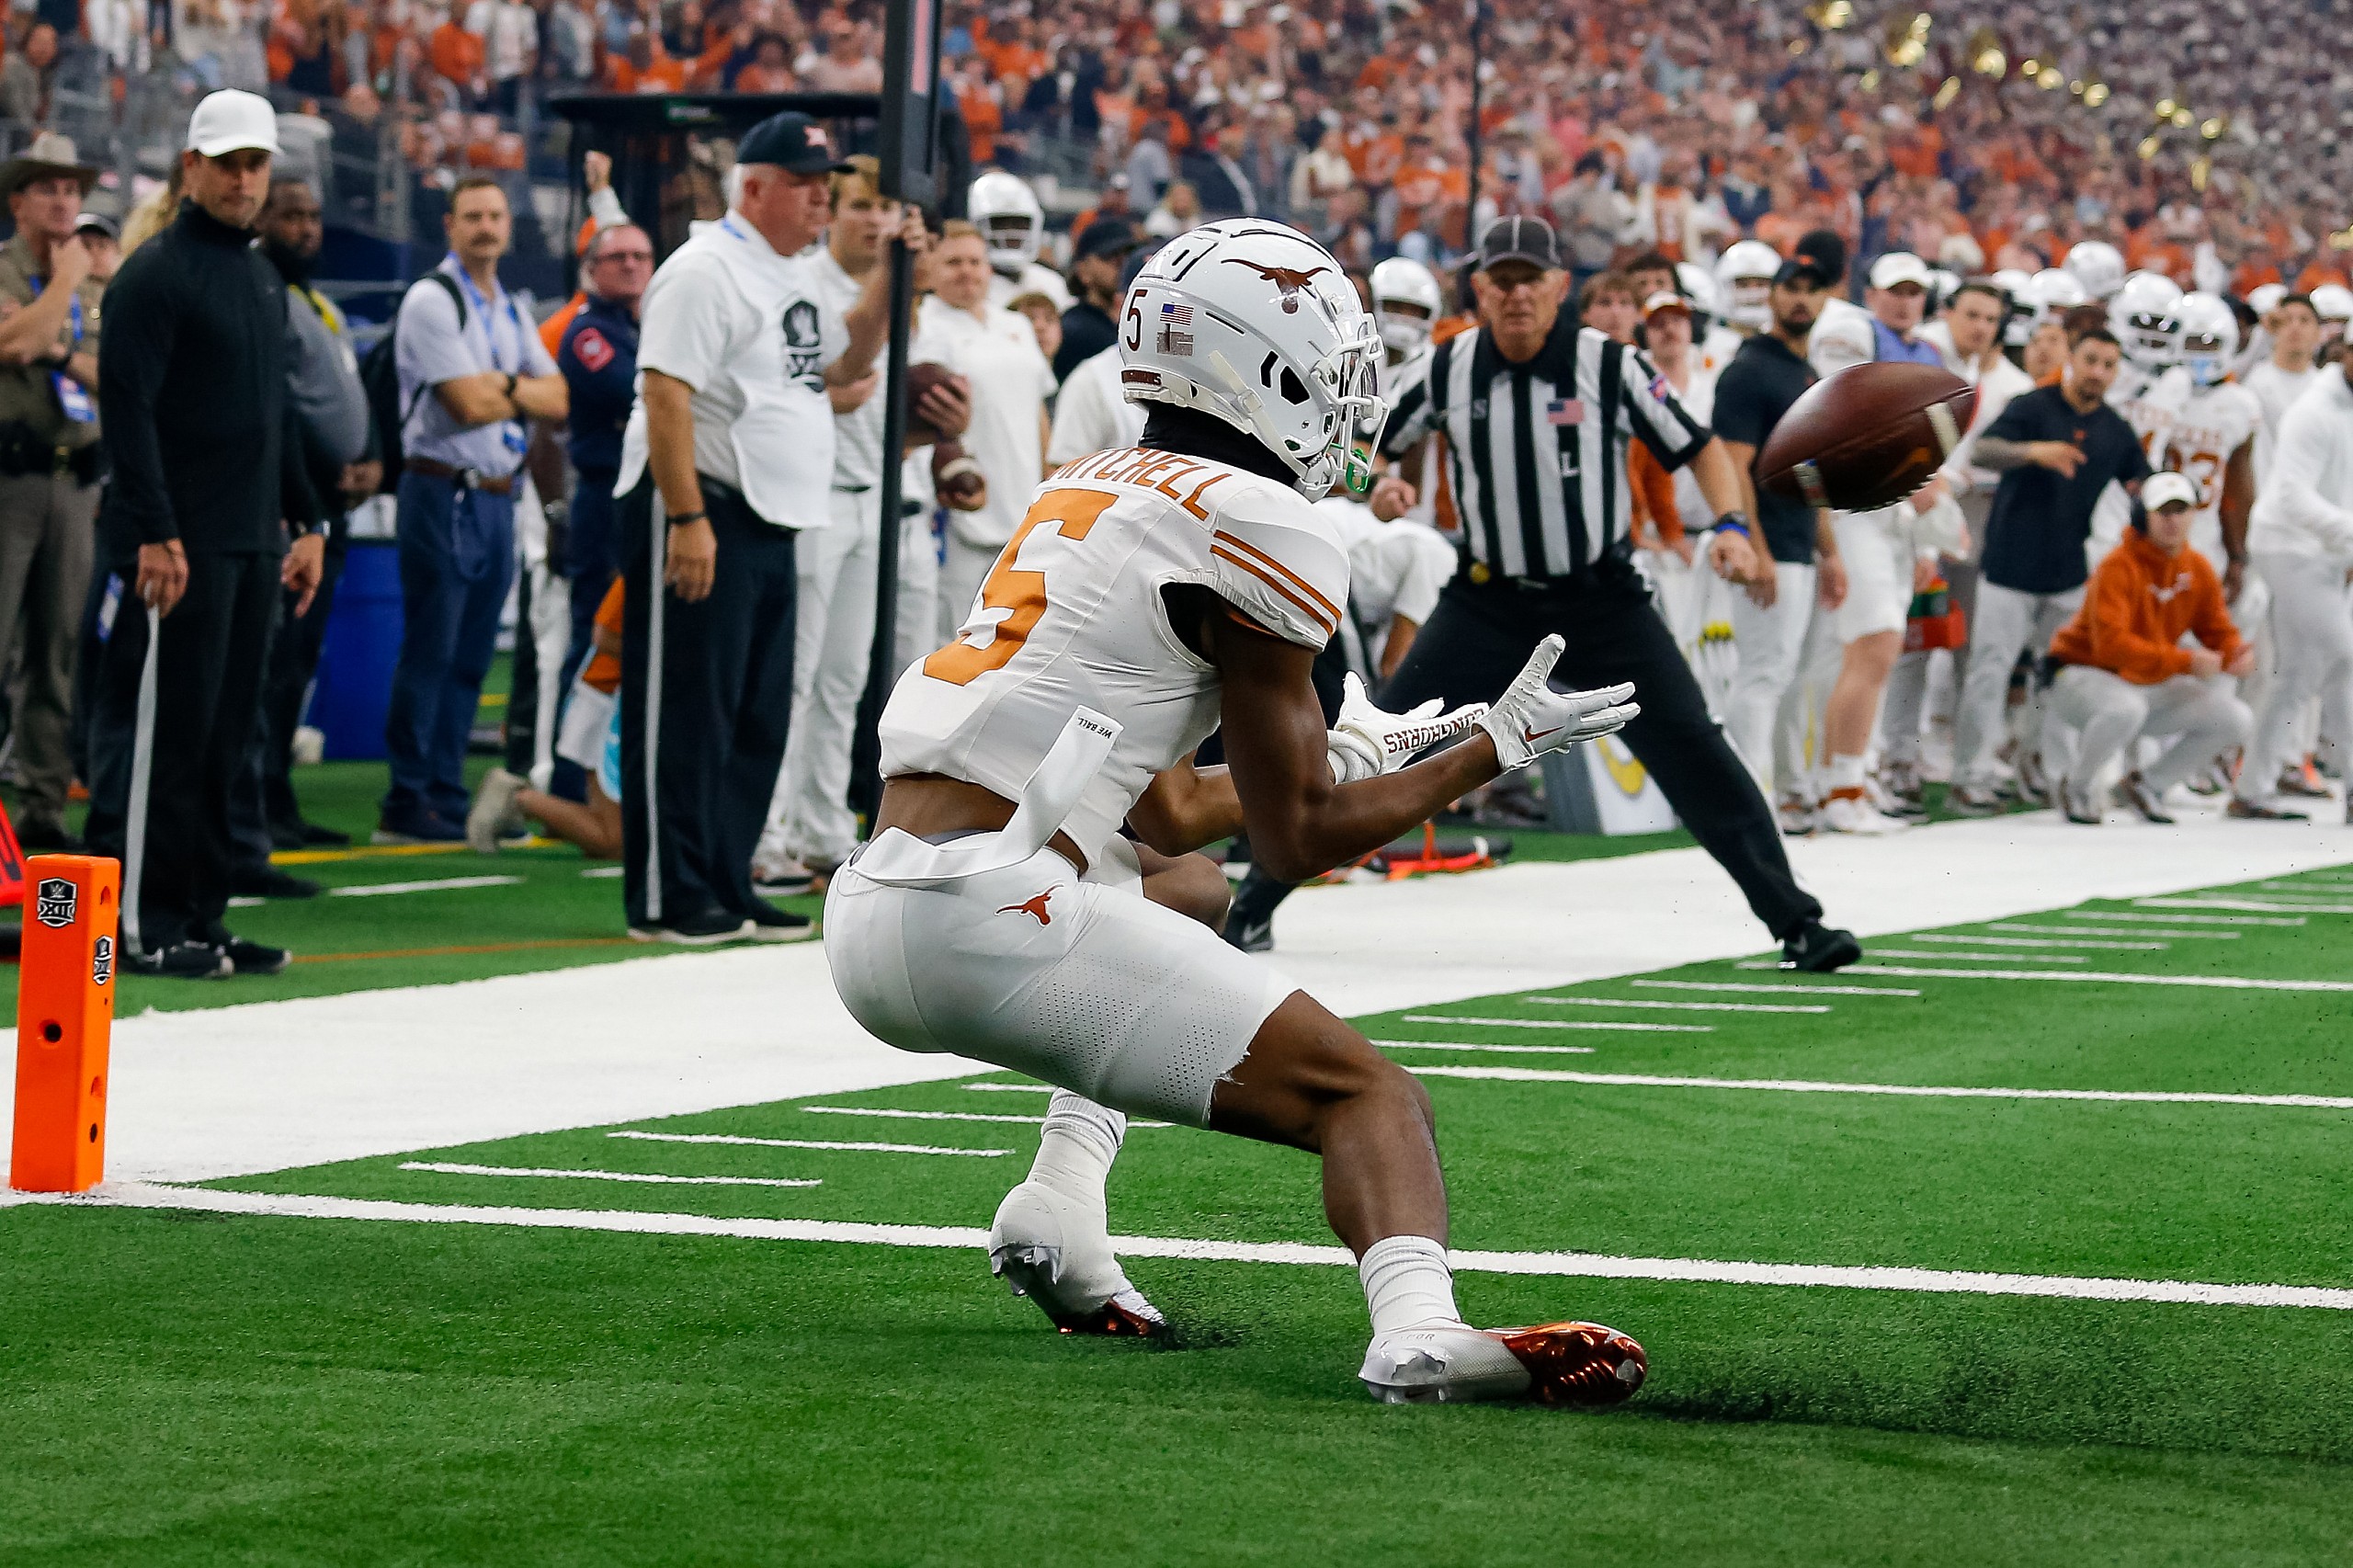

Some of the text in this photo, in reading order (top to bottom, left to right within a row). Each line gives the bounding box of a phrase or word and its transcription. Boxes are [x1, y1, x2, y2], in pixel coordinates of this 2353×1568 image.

[1126, 288, 1148, 352] 5
[1047, 447, 1233, 522] MITCHELL
[1561, 451, 1580, 477] L
[923, 487, 1120, 687] 5
[1097, 726, 1113, 740] WE
